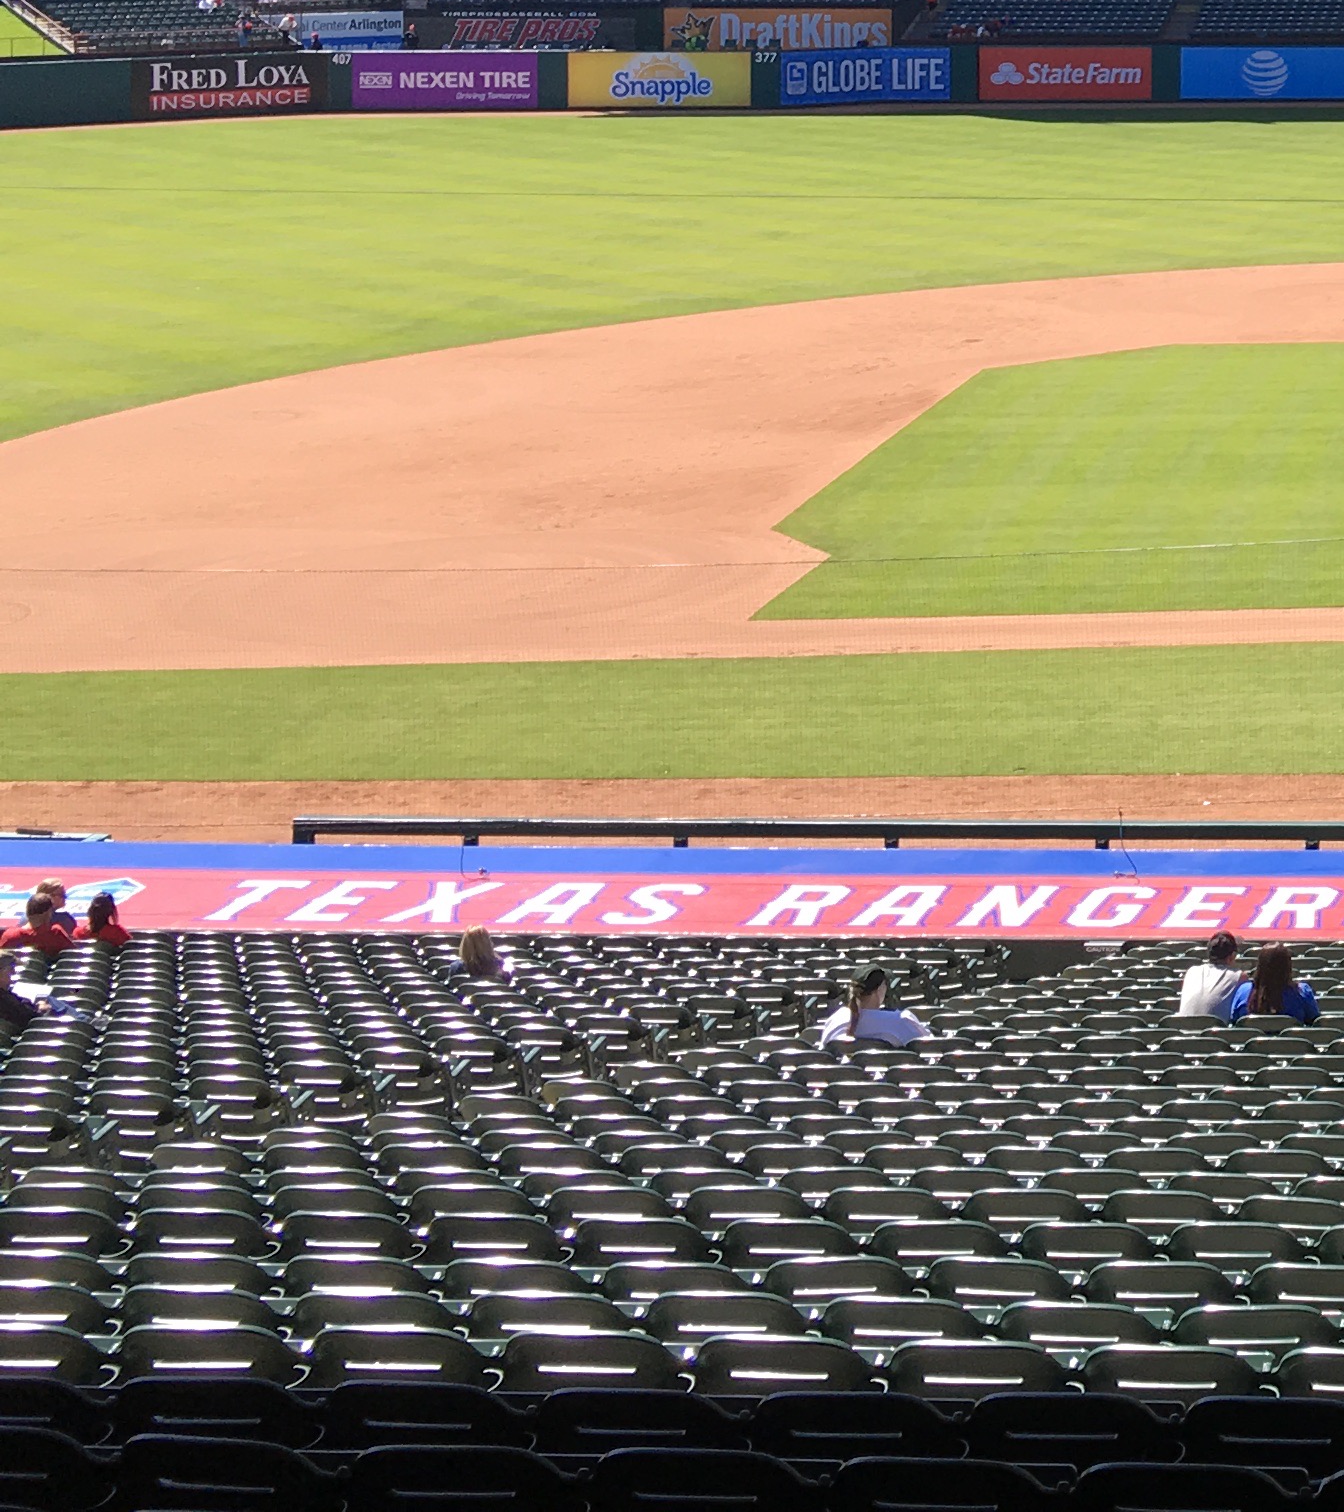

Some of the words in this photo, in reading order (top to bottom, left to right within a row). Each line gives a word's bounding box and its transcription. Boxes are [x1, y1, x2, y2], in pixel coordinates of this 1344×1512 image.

[311, 20, 347, 31] Center
[349, 18, 402, 32] Arlington
[451, 19, 519, 45] TIRE
[515, 19, 602, 48] PROS
[719, 12, 888, 49] DraftKings
[332, 54, 352, 65] 407
[755, 52, 778, 64] 377
[150, 62, 227, 92] FRED
[235, 59, 310, 88] LOYA
[400, 72, 475, 88] NEXEN
[479, 72, 531, 88] TIRE
[611, 71, 714, 104] Snapple
[813, 60, 882, 94] GLOBE
[892, 58, 945, 91] LIFE
[152, 89, 309, 111] INSURANCE
[203, 879, 708, 926] TEXAS
